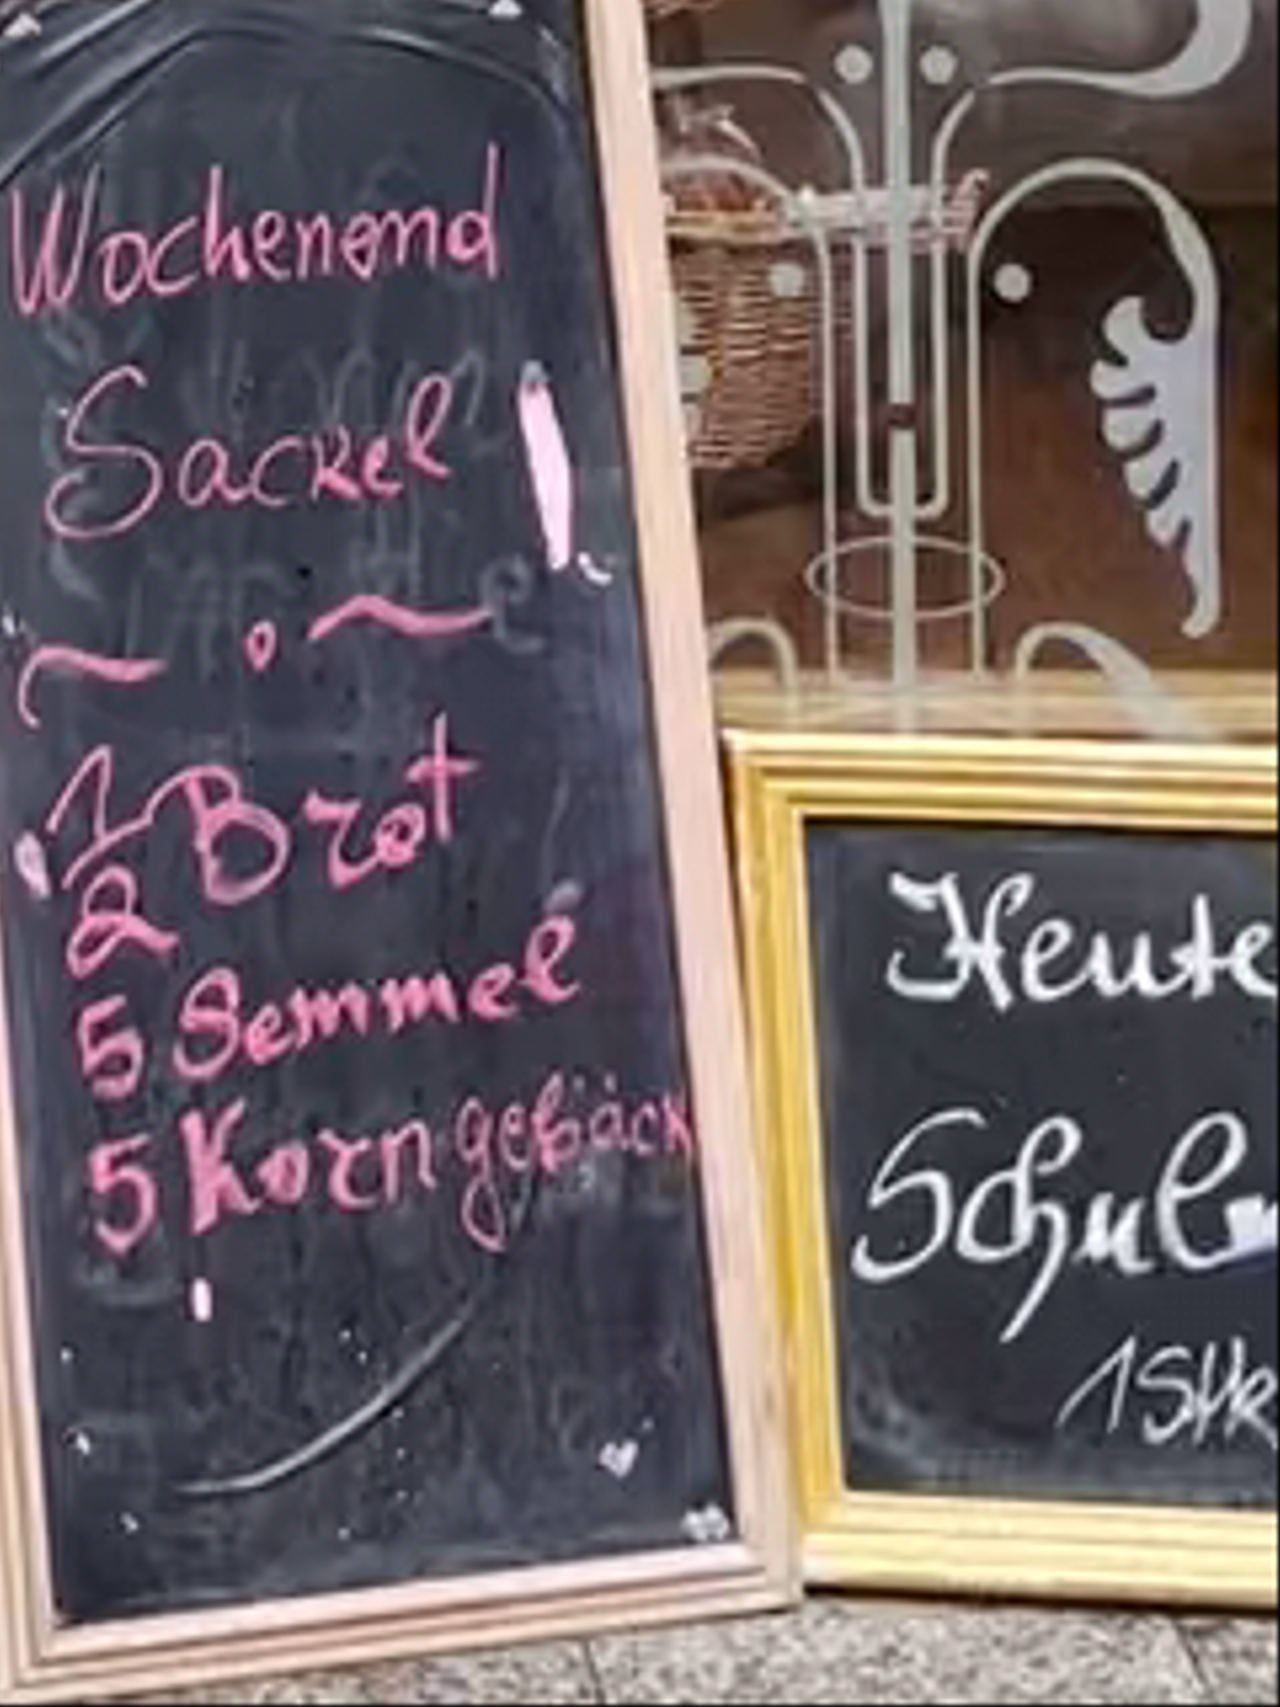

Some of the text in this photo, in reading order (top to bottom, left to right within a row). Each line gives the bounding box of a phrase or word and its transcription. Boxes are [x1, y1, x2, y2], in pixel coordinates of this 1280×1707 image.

[9, 141, 503, 316] Wochenend
[75, 915, 579, 1100] 5 Semmel
[886, 872, 1278, 1012] Heute
[88, 1134, 157, 1257] 5
